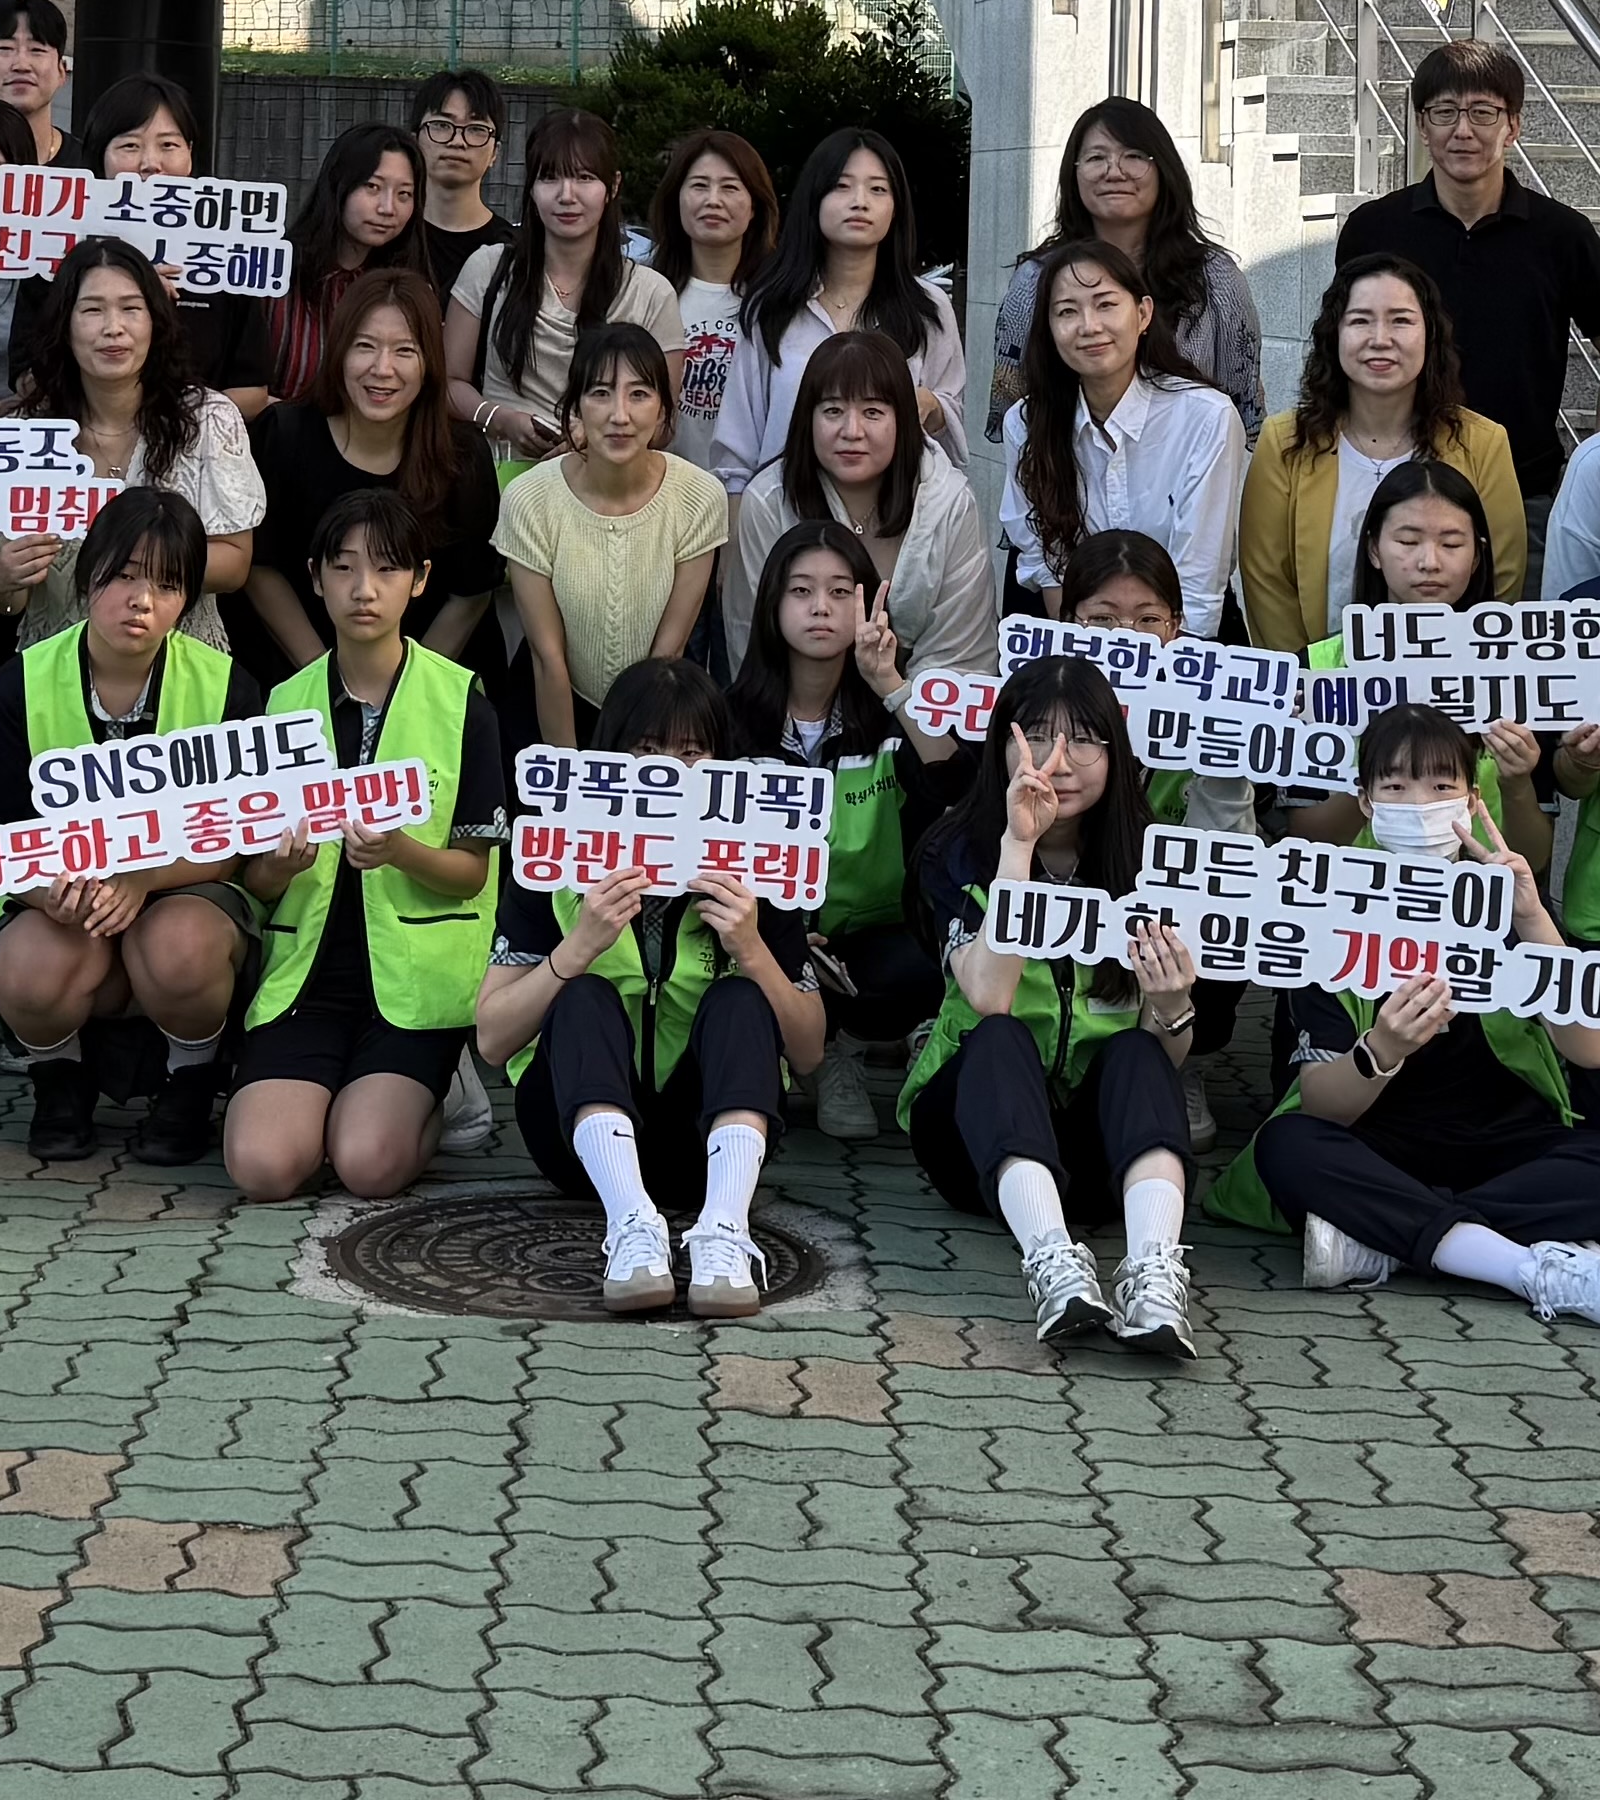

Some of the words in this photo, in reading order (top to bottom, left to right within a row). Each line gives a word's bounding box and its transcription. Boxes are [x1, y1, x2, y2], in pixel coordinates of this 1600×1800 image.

[3, 172, 90, 220] 내가
[104, 181, 279, 233] 소중하면
[1351, 611, 1453, 663] 너도
[1172, 646, 1290, 710] 학교!
[1429, 674, 1585, 725] 될지도
[38, 717, 326, 809] SNS에서도
[524, 754, 684, 819] 학폭은
[699, 768, 825, 830] 자폭!
[183, 791, 287, 854] 좋은
[302, 766, 423, 834] 말만!
[521, 826, 678, 886] 방관도
[697, 838, 821, 901] 폭력!
[1145, 833, 1259, 899] 모든
[1277, 847, 1504, 933] 친구들이
[994, 888, 1106, 955] 네가
[1200, 912, 1310, 978] 일을
